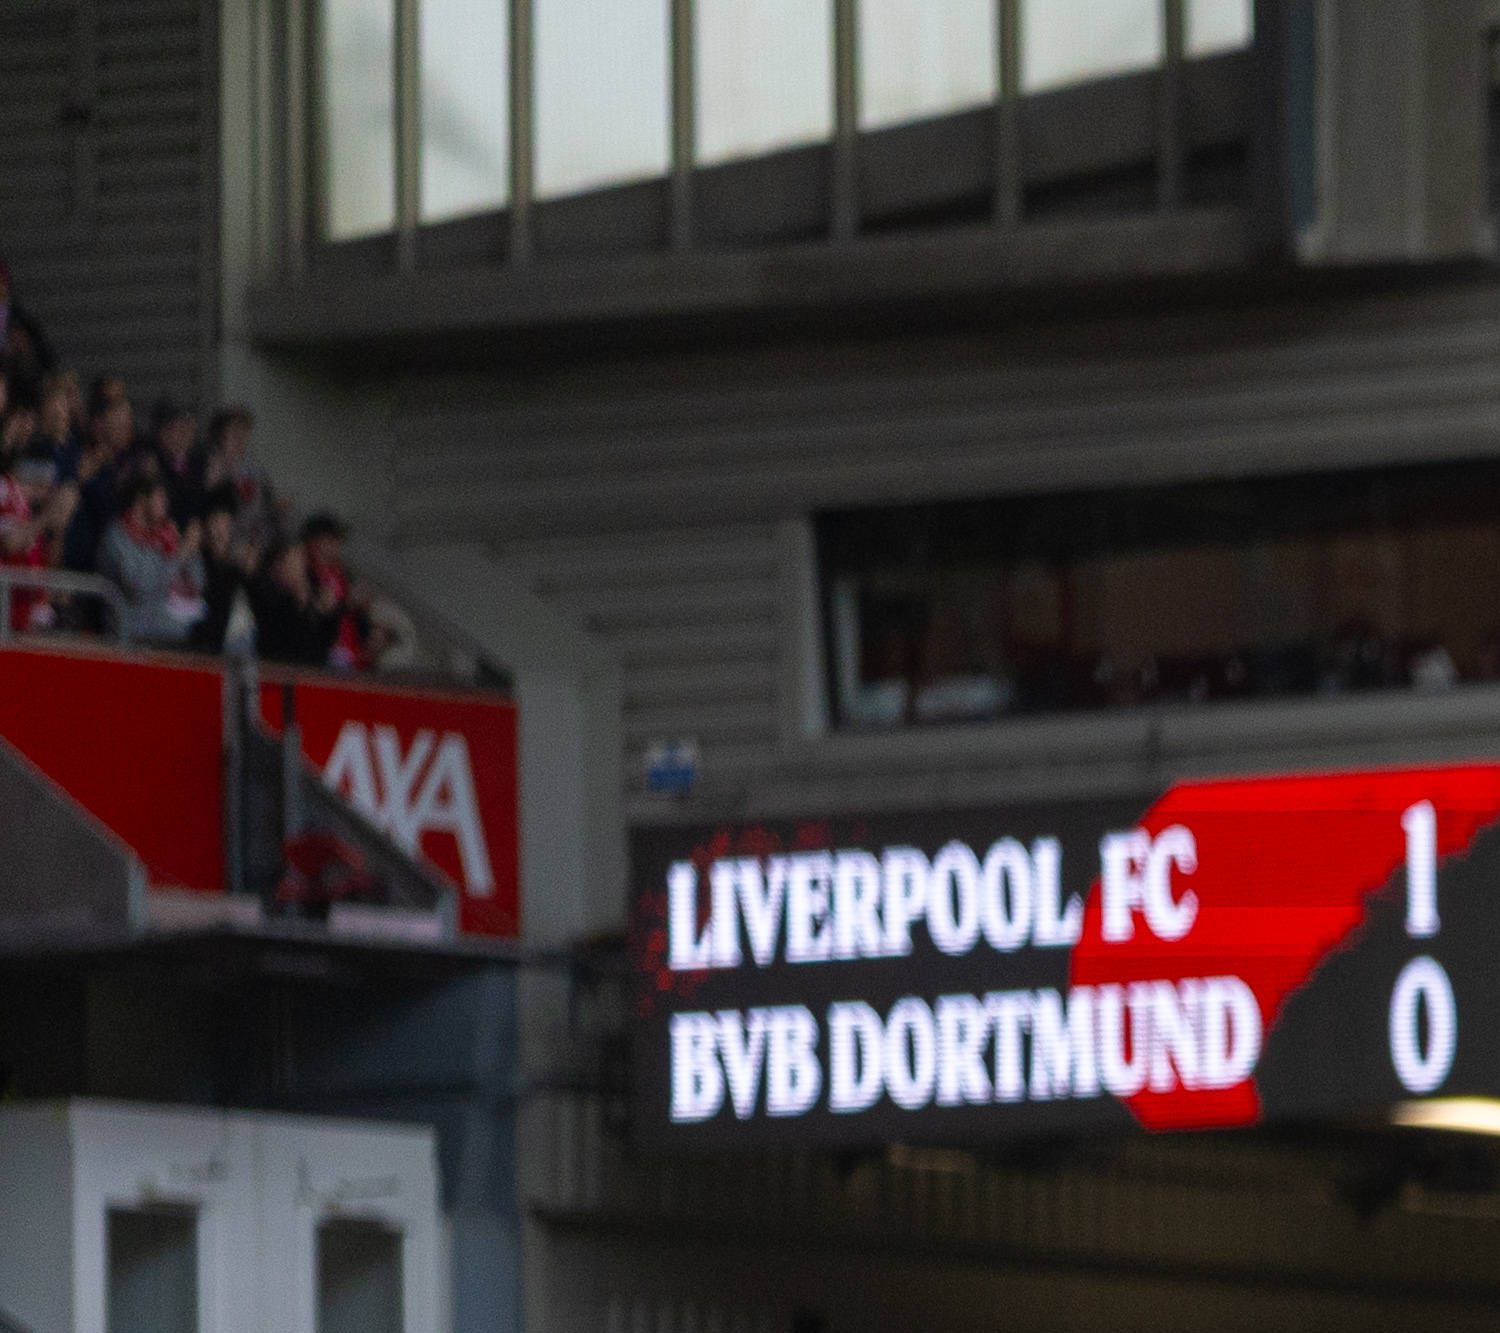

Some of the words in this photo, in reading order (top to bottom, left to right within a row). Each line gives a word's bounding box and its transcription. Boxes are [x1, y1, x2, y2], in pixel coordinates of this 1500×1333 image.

[666, 834, 1085, 972] LIVERPOOL
[1099, 822, 1199, 944] FC
[1401, 798, 1441, 939] 1
[668, 1002, 823, 1124] BVB
[827, 974, 1263, 1115] DORTMUND
[1388, 954, 1459, 1094] 0
